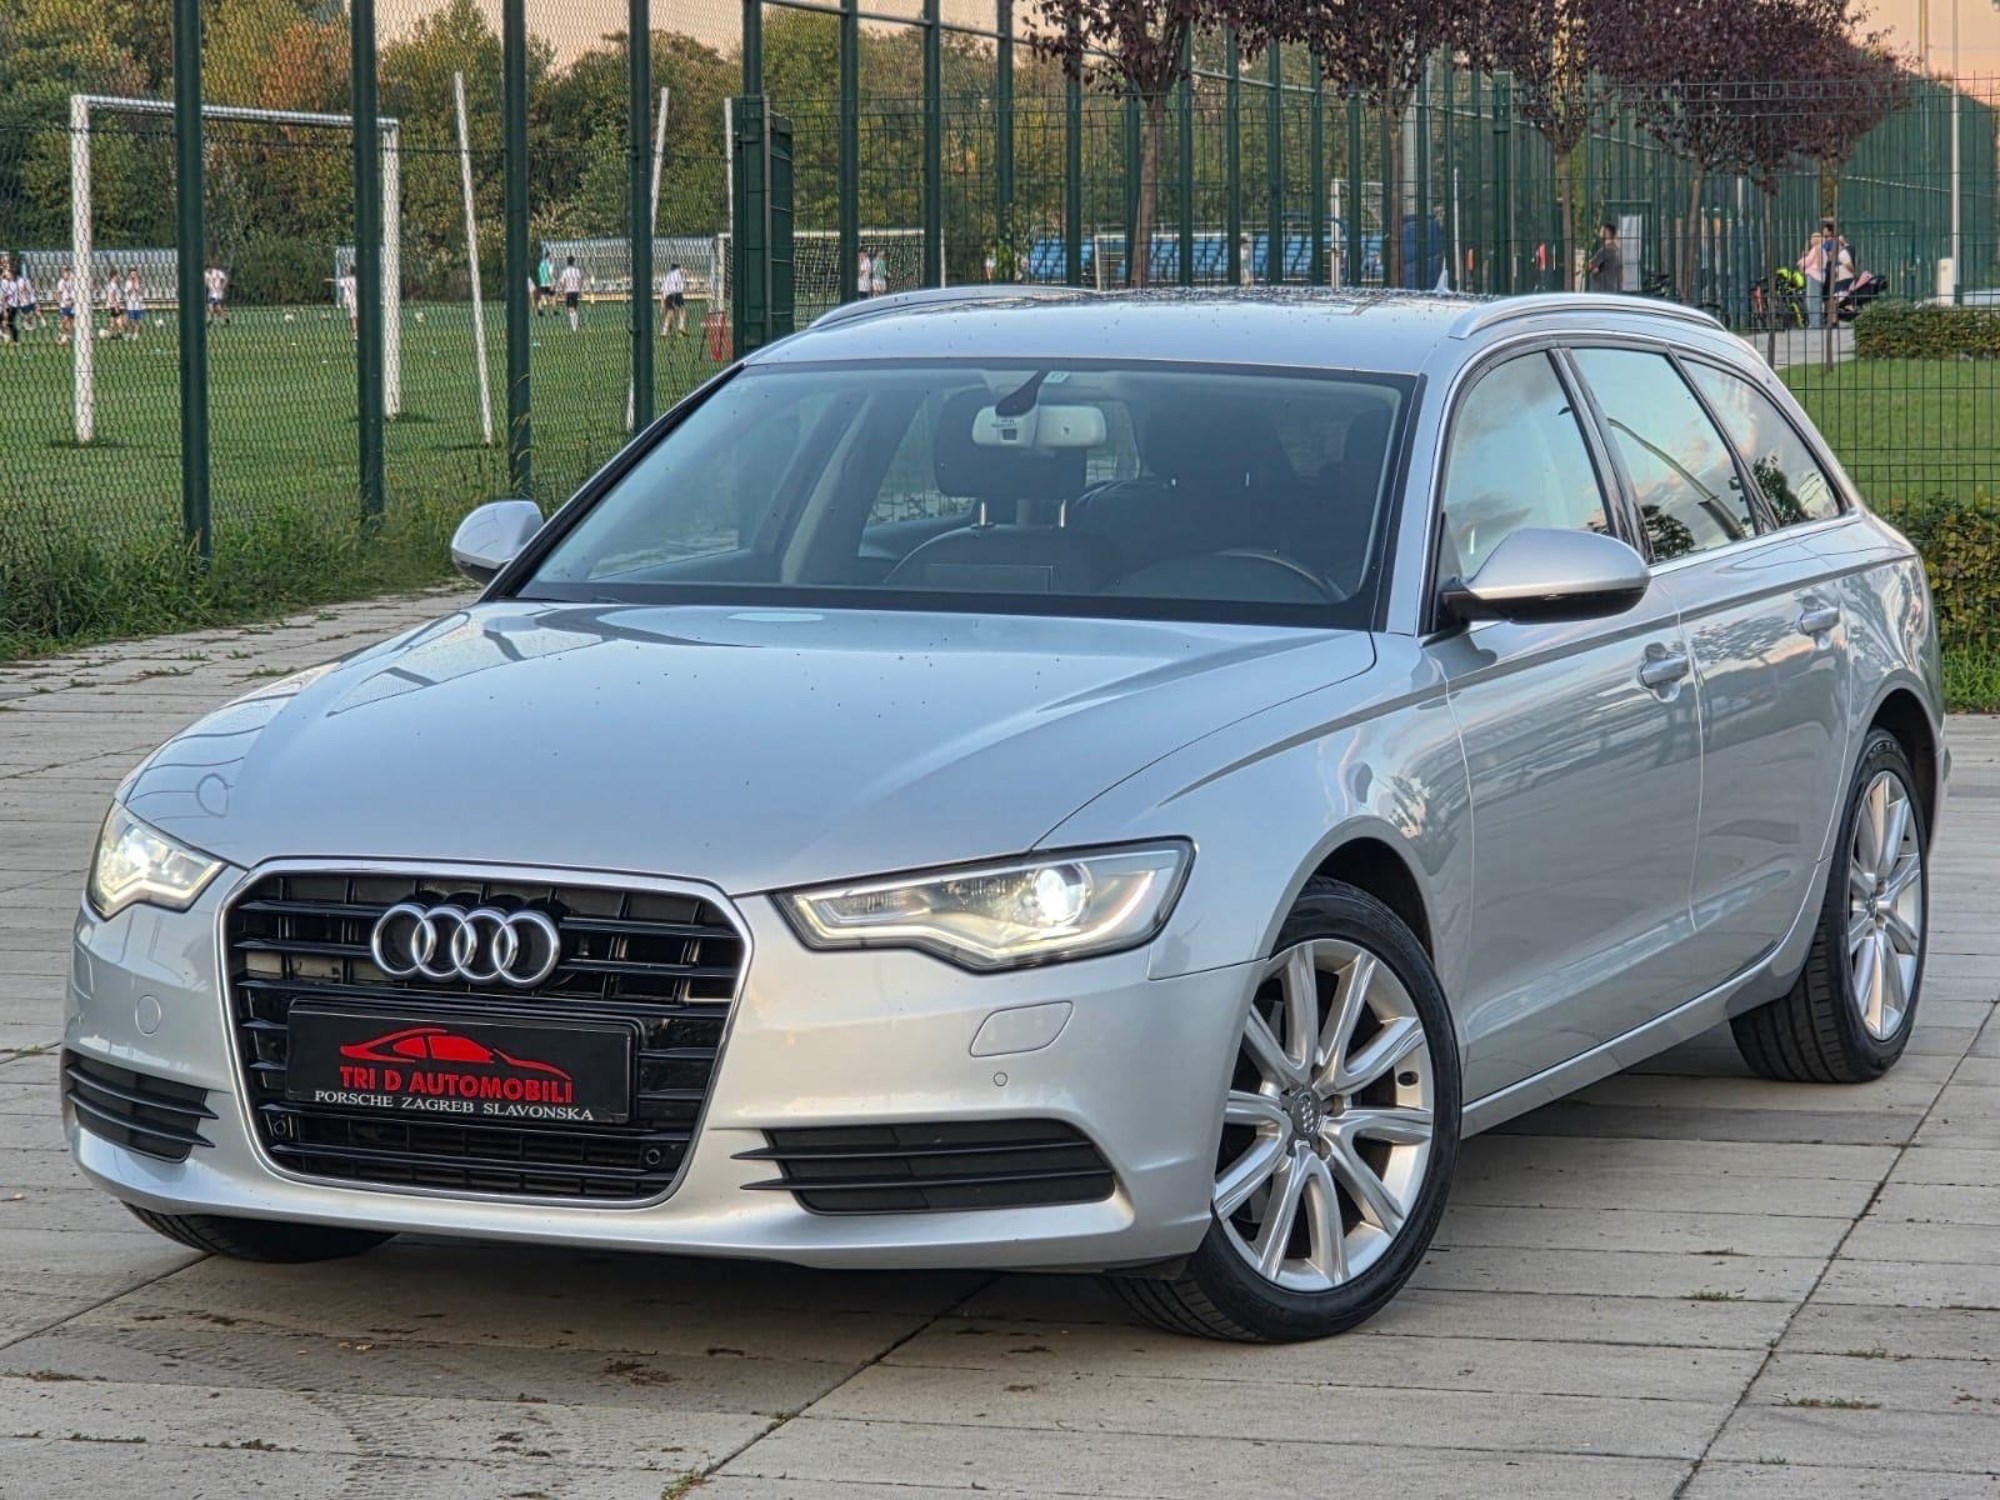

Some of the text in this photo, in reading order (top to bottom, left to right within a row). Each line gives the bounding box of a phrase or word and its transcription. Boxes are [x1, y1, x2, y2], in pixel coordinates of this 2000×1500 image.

[340, 1066, 572, 1103] TRI D AUTOMOBILI
[315, 1090, 594, 1120] PORSCHE ZAGREB SLAVONSKA
